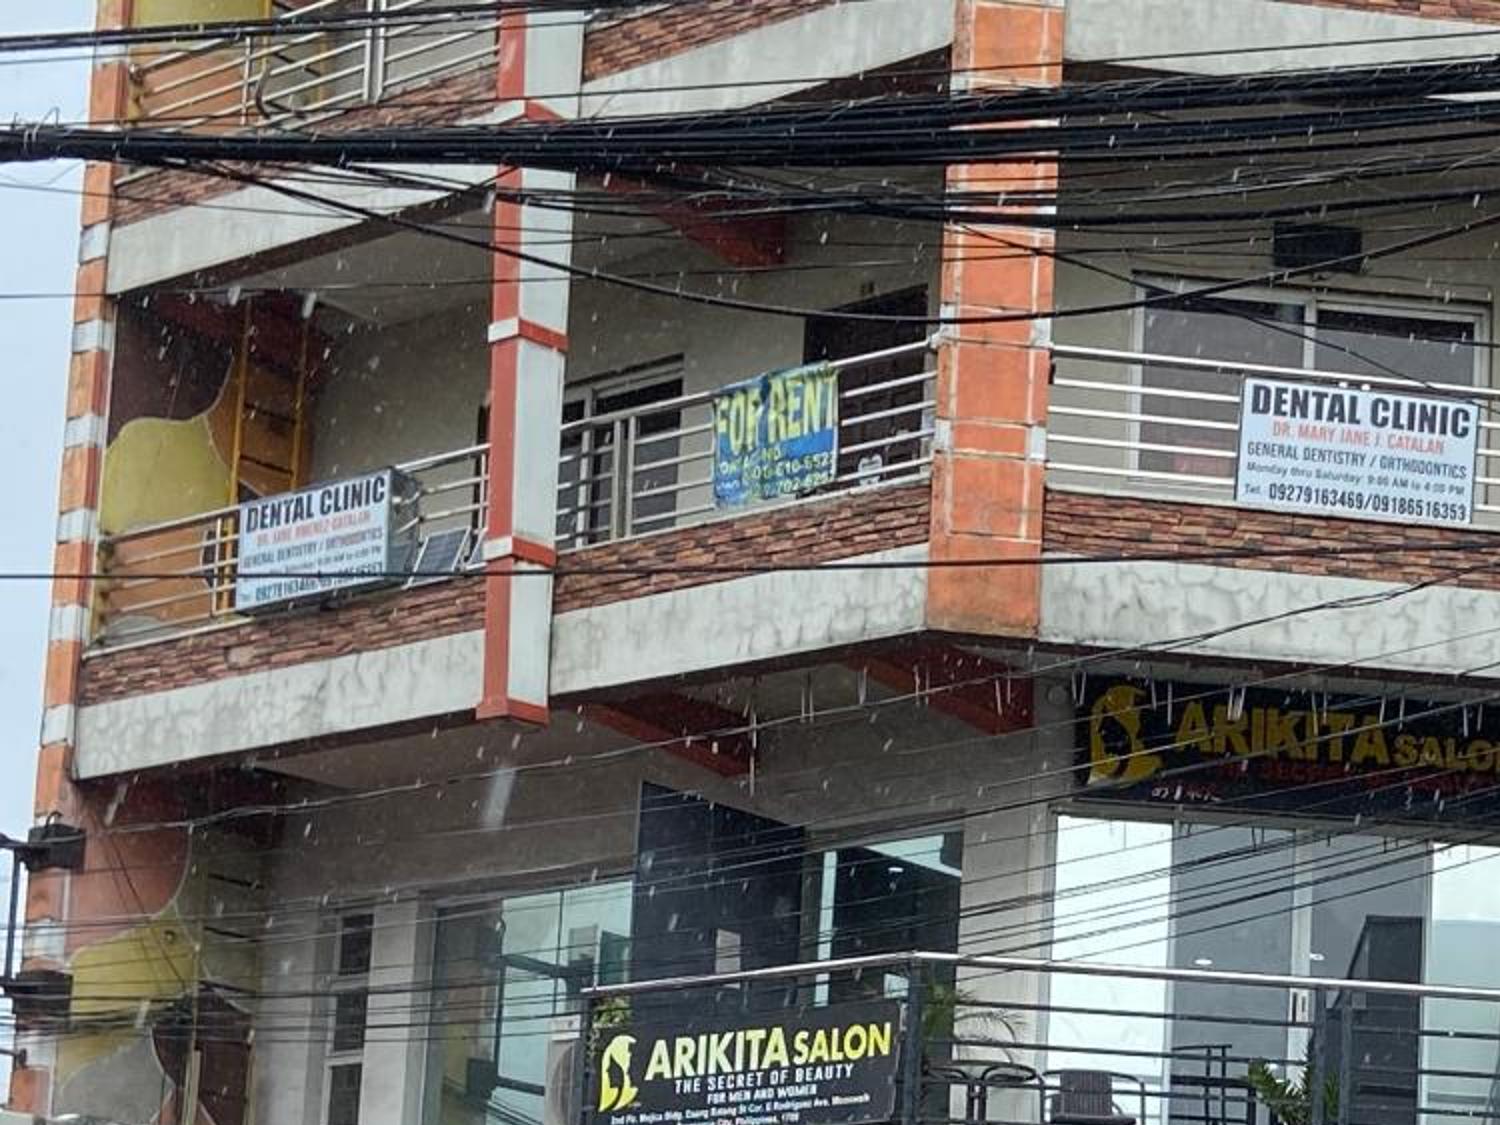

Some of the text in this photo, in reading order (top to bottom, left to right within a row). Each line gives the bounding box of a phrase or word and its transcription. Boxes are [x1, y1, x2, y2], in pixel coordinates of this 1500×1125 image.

[717, 376, 838, 454] FOR RENT
[1251, 384, 1470, 438] DENTAL CLINIC
[1247, 442, 1298, 460] GENERAL
[1303, 445, 1366, 466] DENTISTRY
[1379, 456, 1467, 479] ORTHODONTICS
[1298, 423, 1336, 442] MARY
[1340, 427, 1371, 445] JANE
[1387, 433, 1445, 454] CATALAN
[1247, 461, 1287, 477] Monday
[1290, 465, 1312, 478] thru
[1392, 477, 1408, 488] AM
[1449, 484, 1465, 496] PM
[246, 476, 386, 533] DENTAL CLINIC
[1175, 698, 1391, 766] ARIKITA
[644, 1022, 892, 1081] ARIKITA SALON
[674, 1063, 855, 1095] THE SECRET OF BEAUTY
[707, 1084, 817, 1105] FOR MEN AND WOMEN
